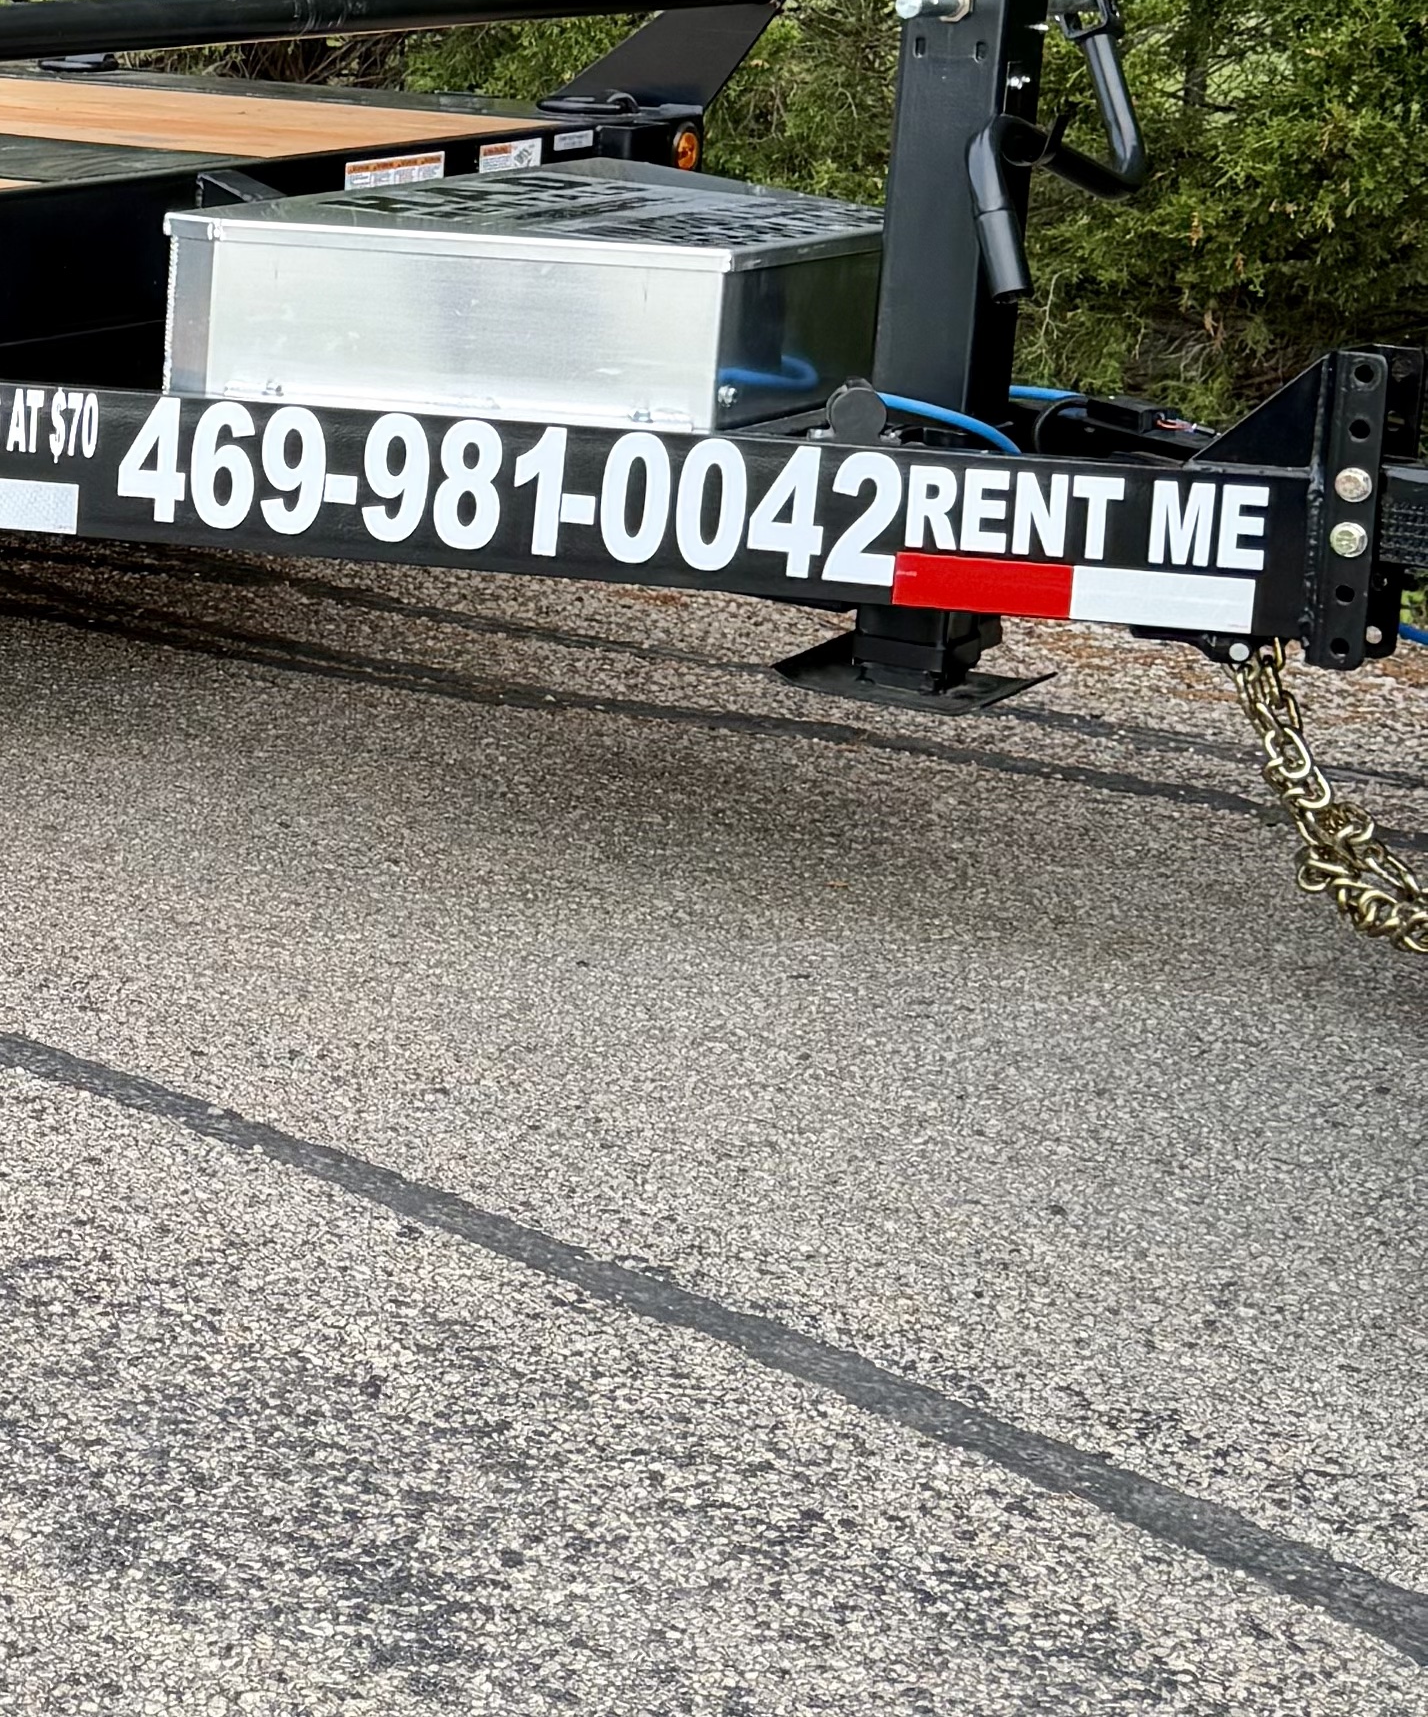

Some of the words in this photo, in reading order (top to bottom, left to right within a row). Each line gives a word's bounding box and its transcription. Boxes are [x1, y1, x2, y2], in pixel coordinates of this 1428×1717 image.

[6, 388, 45, 453] AT
[49, 386, 99, 464] $70
[117, 396, 902, 587] 469-981-0042
[904, 464, 1125, 560] RENT
[1148, 479, 1270, 571] ME
